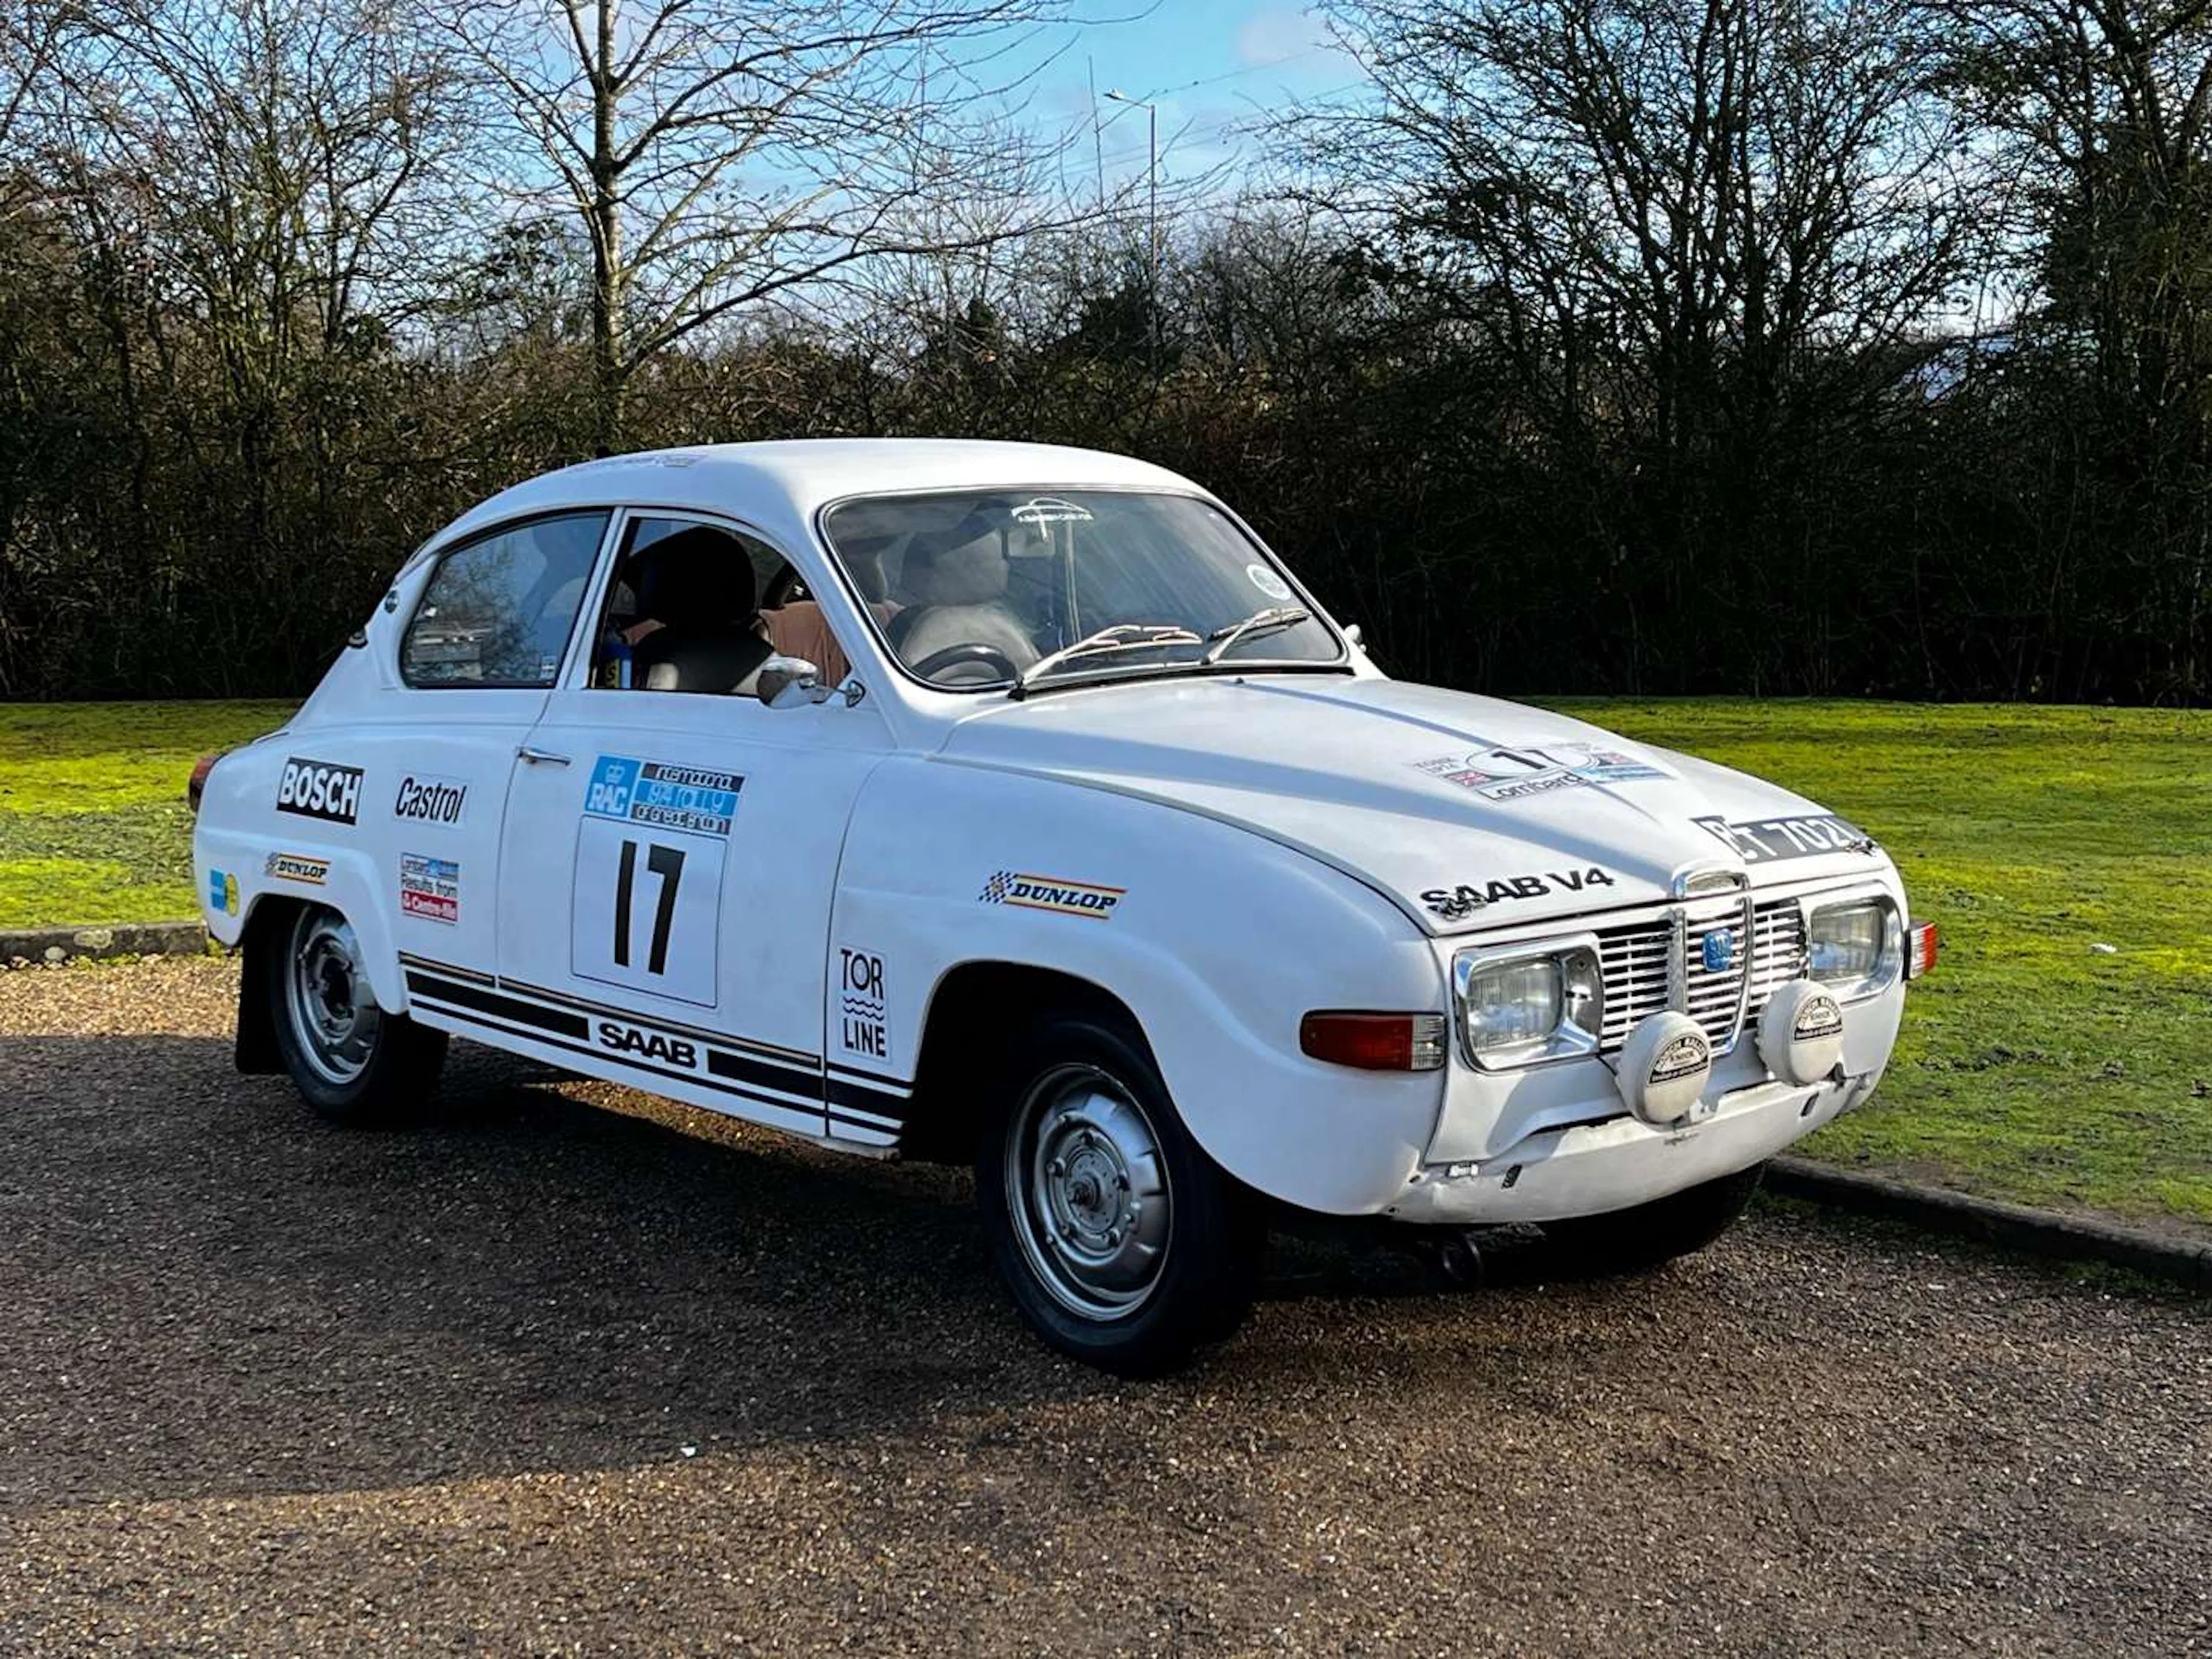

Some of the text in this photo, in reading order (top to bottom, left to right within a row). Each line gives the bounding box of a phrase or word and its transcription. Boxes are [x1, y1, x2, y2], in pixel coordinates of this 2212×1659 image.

[279, 763, 362, 817] BOSCH
[395, 777, 466, 824] Castrol
[587, 783, 628, 813] RAC
[1475, 770, 1584, 801] Lombard
[278, 861, 327, 878] DUNLOP
[1419, 868, 1615, 916] SAAB V4
[613, 840, 686, 975] 17
[1011, 882, 1118, 910] DUNLOP
[840, 948, 884, 1000] TOR
[597, 1022, 696, 1070] SAAB
[844, 1017, 887, 1058] LINE
